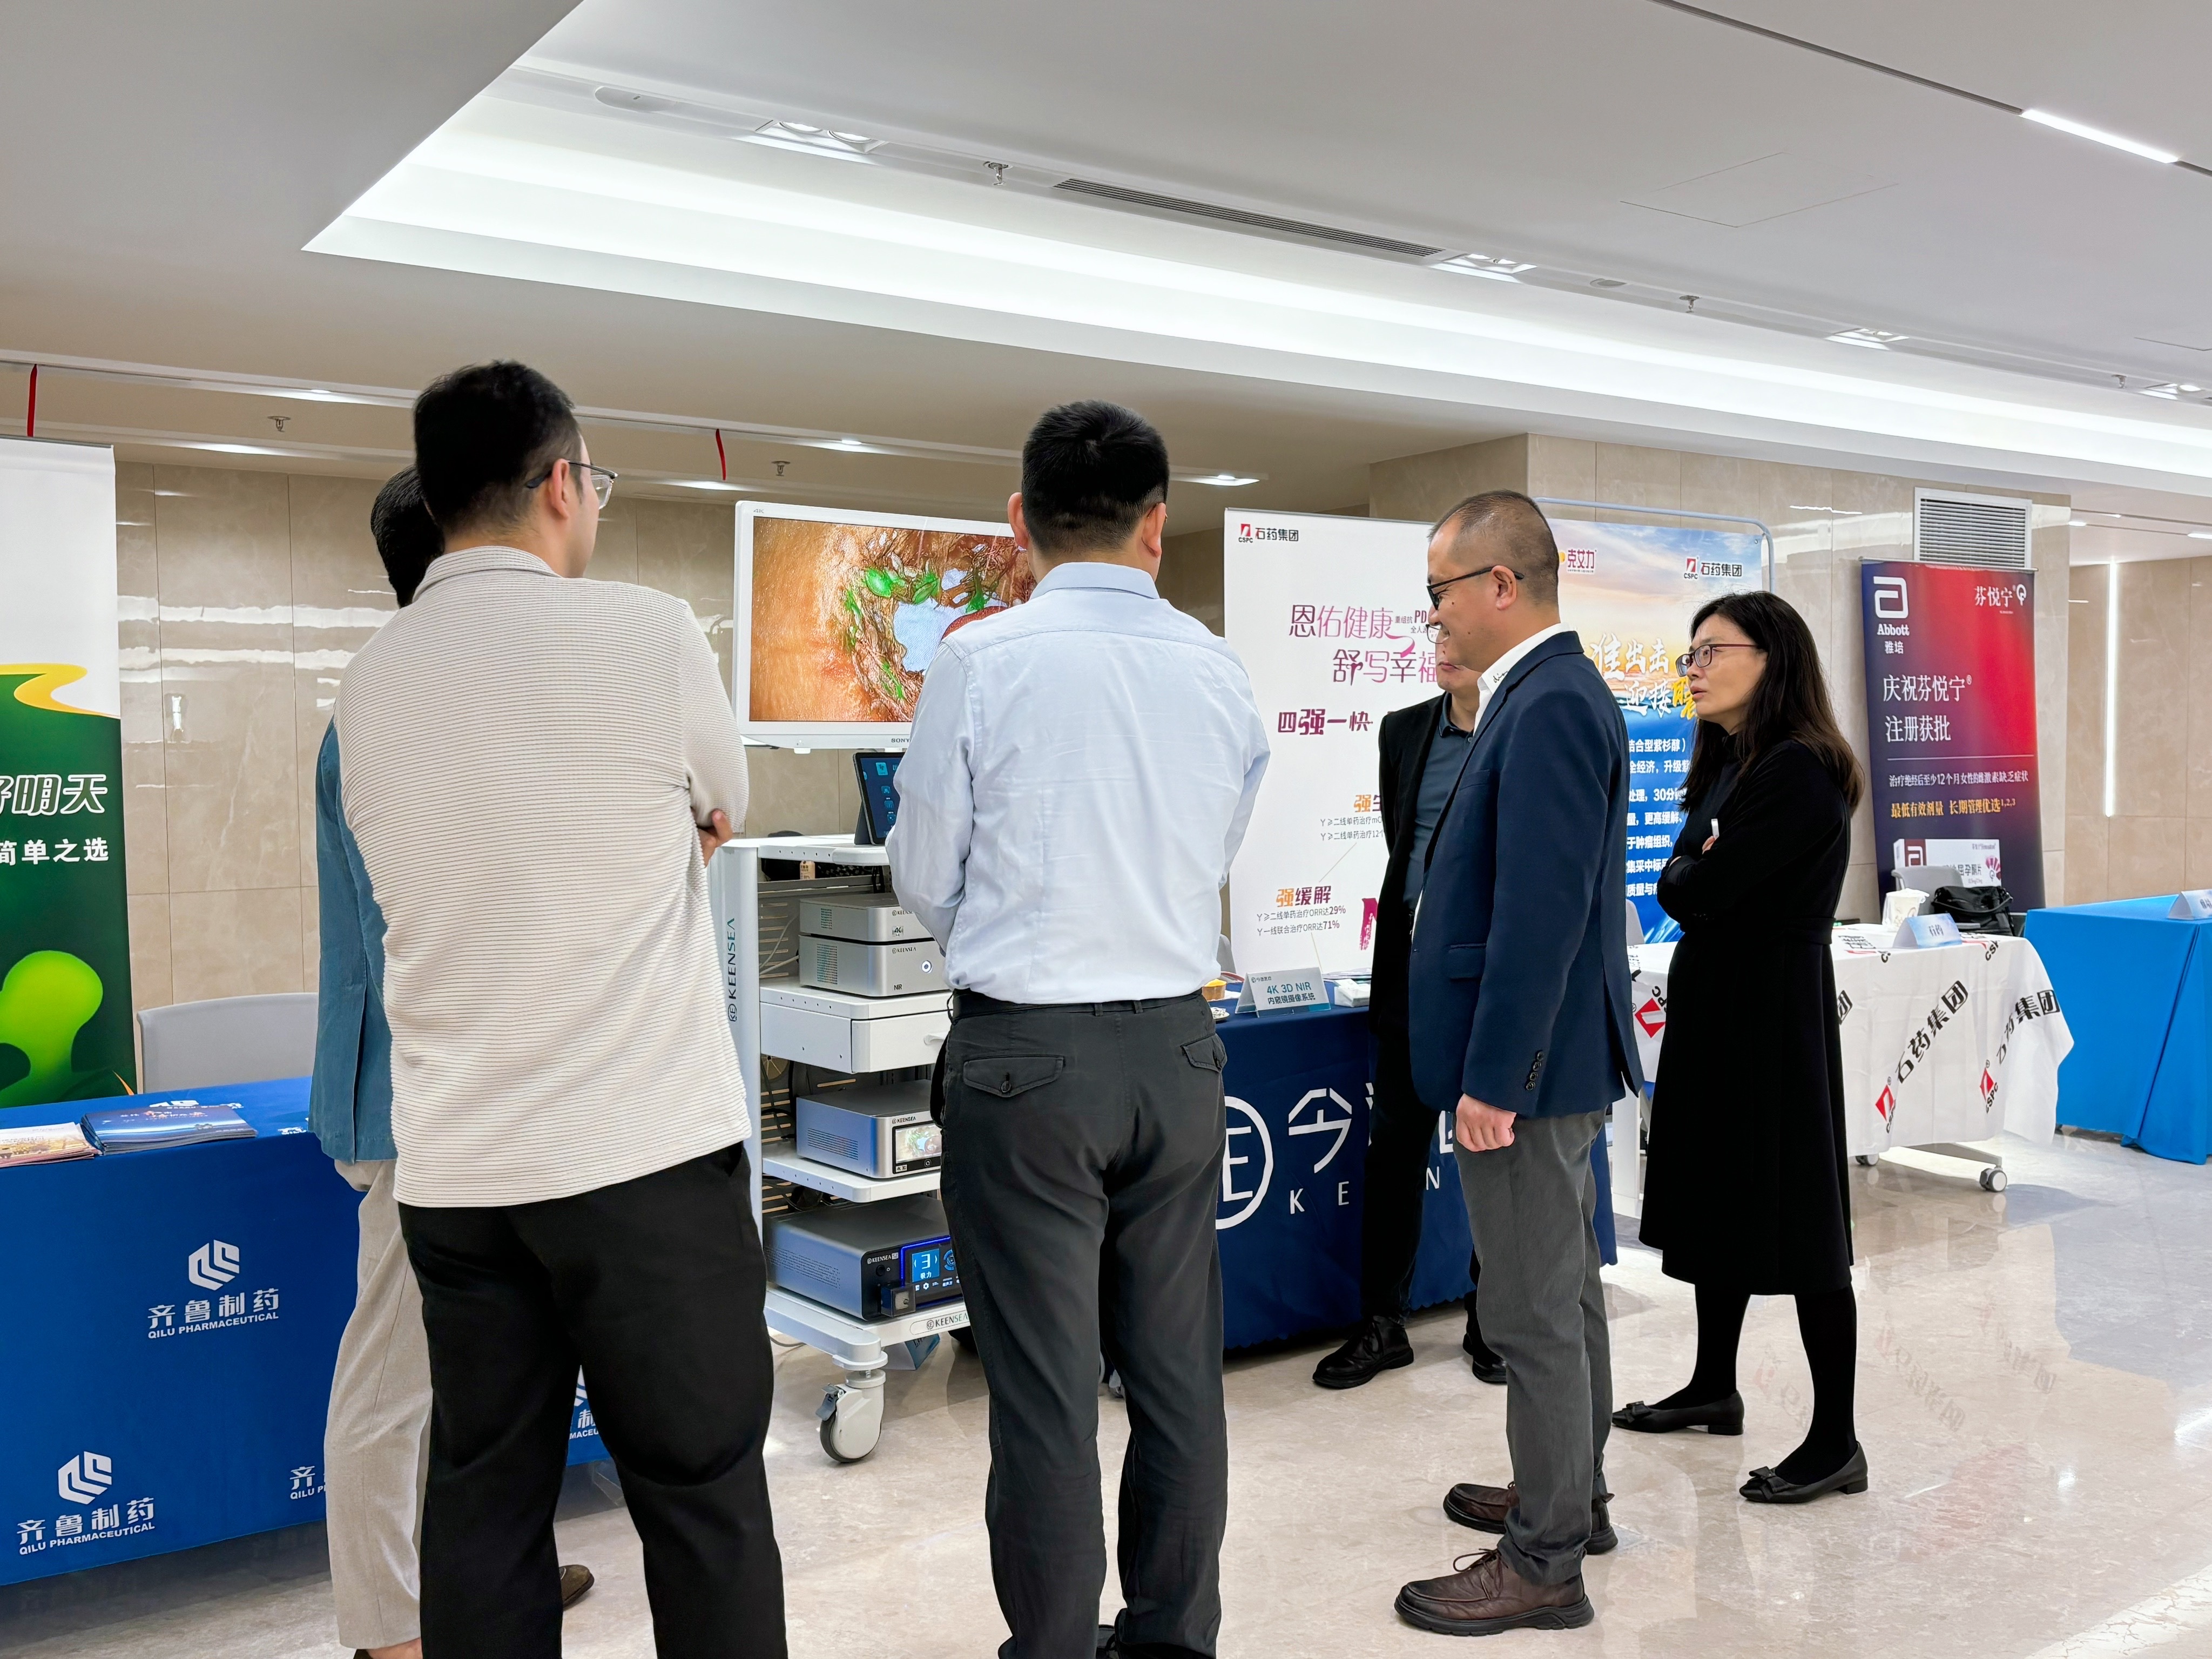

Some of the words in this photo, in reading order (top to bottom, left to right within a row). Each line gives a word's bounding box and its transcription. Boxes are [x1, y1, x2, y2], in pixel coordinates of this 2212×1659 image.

[1255, 527, 1299, 542] 石药集团
[1568, 549, 1595, 569] 克艾力
[1701, 562, 1742, 577] 石药集团
[1289, 604, 1393, 639] 恩佑健康
[1877, 623, 1910, 636] Abbott
[1884, 640, 1904, 655] 雅培
[1332, 649, 1437, 686] 舒写幸福
[1278, 709, 1373, 736] 四强一快
[1885, 714, 1951, 743] 注册获批
[1891, 800, 1944, 819] 最低有效剂量
[0, 837, 109, 866] 简单之选
[1276, 885, 1332, 908] 强缓解
[727, 918, 737, 1000] KEENSEA
[1267, 984, 1279, 995] 4K
[1281, 983, 1293, 993] 3D
[1296, 981, 1312, 992] NIR
[1894, 980, 1968, 1084] 石药集团
[872, 1254, 892, 1263] KEENSEA
[147, 1288, 279, 1329] 齐鲁制药
[935, 1313, 968, 1327] KEENSEA
[148, 1328, 176, 1339] QILU
[179, 1312, 279, 1334] PHARMACEUTICAL
[290, 1488, 315, 1500] QILU
[17, 1497, 154, 1545] 齐鲁制药
[19, 1542, 46, 1555] QILU
[50, 1521, 155, 1548] PHARMACEUTICAL
